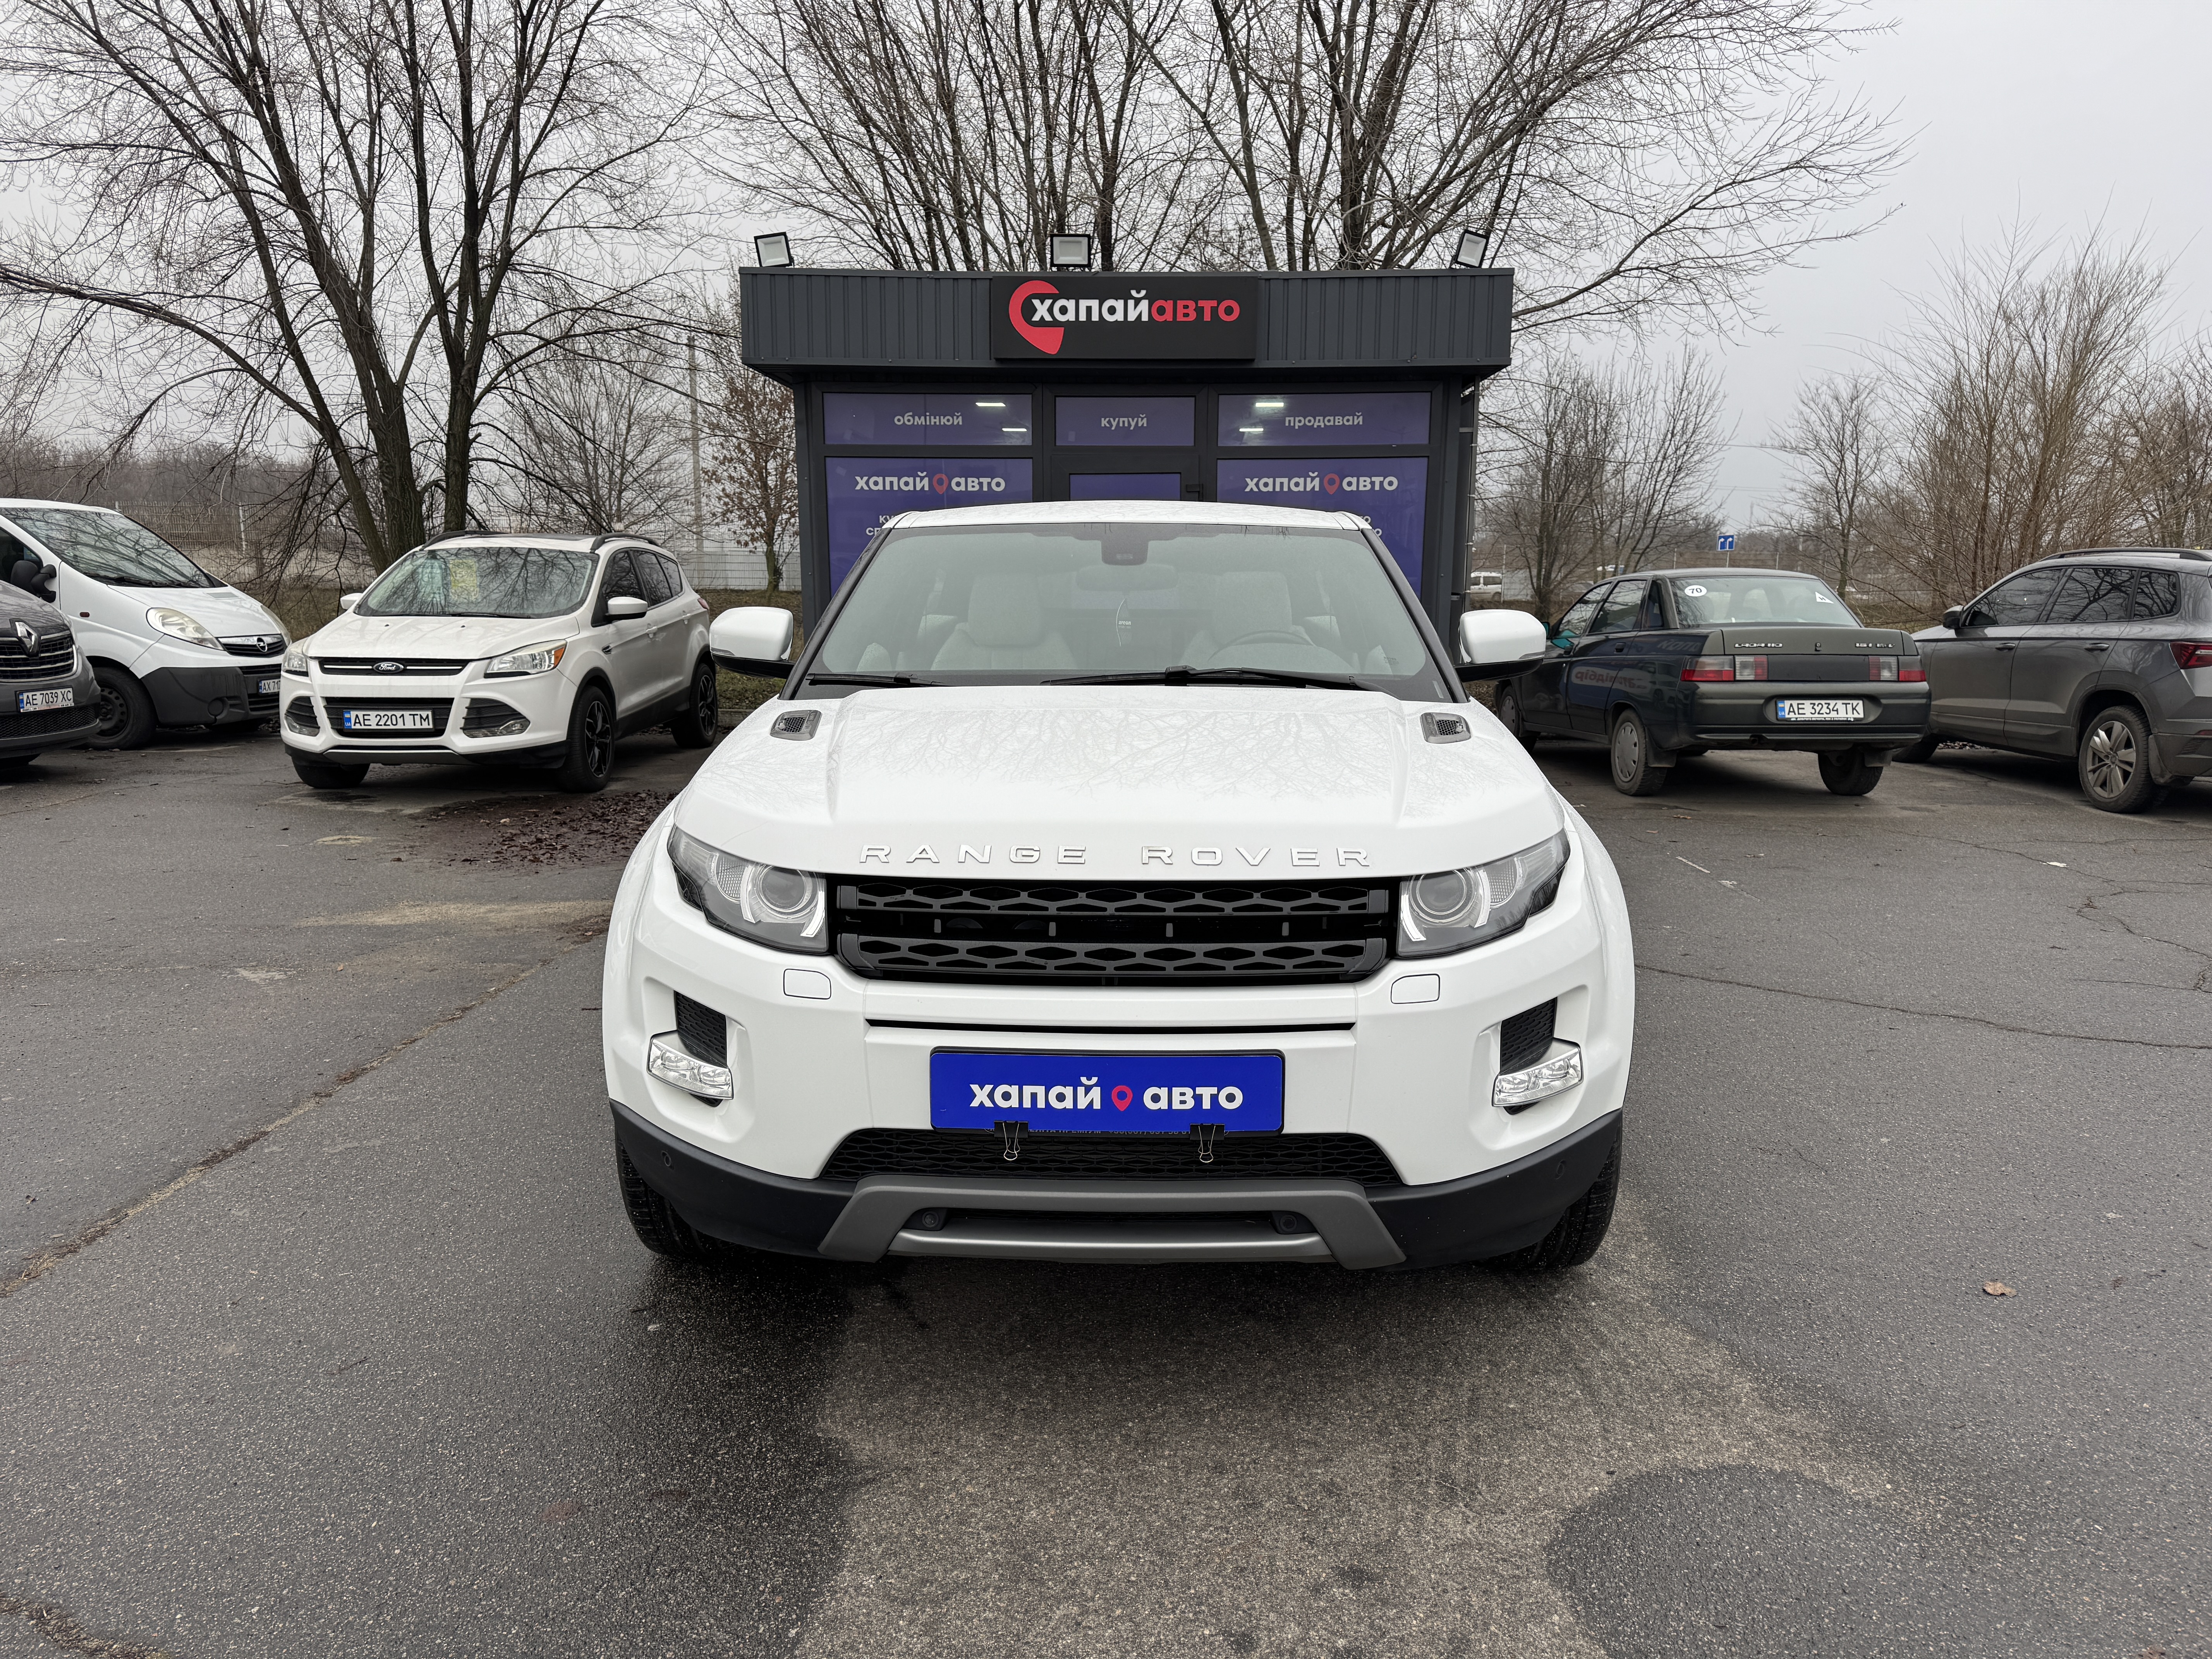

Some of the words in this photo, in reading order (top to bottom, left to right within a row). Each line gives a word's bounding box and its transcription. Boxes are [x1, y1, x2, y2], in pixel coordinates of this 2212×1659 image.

[894, 412, 962, 425] обмінюй
[1101, 414, 1147, 430] купуй
[1285, 412, 1363, 429] продавай
[855, 471, 929, 491] хапай
[951, 477, 1006, 491] авто
[1244, 471, 1320, 492] хапай
[1342, 476, 1398, 491] авто
[263, 681, 271, 692] AX
[26, 694, 38, 707] AE
[40, 691, 58, 705] 7039
[60, 690, 72, 703] XC
[1787, 702, 1806, 715] AE
[1810, 702, 1839, 715] 3234
[1841, 702, 1861, 715] TK
[353, 713, 372, 726] AE
[374, 713, 405, 726] 2201
[409, 713, 430, 726] TM
[859, 844, 1087, 864] RANGE
[1141, 845, 1370, 868] ROVER
[969, 1076, 1101, 1110] хапай
[1143, 1085, 1244, 1110] авто
